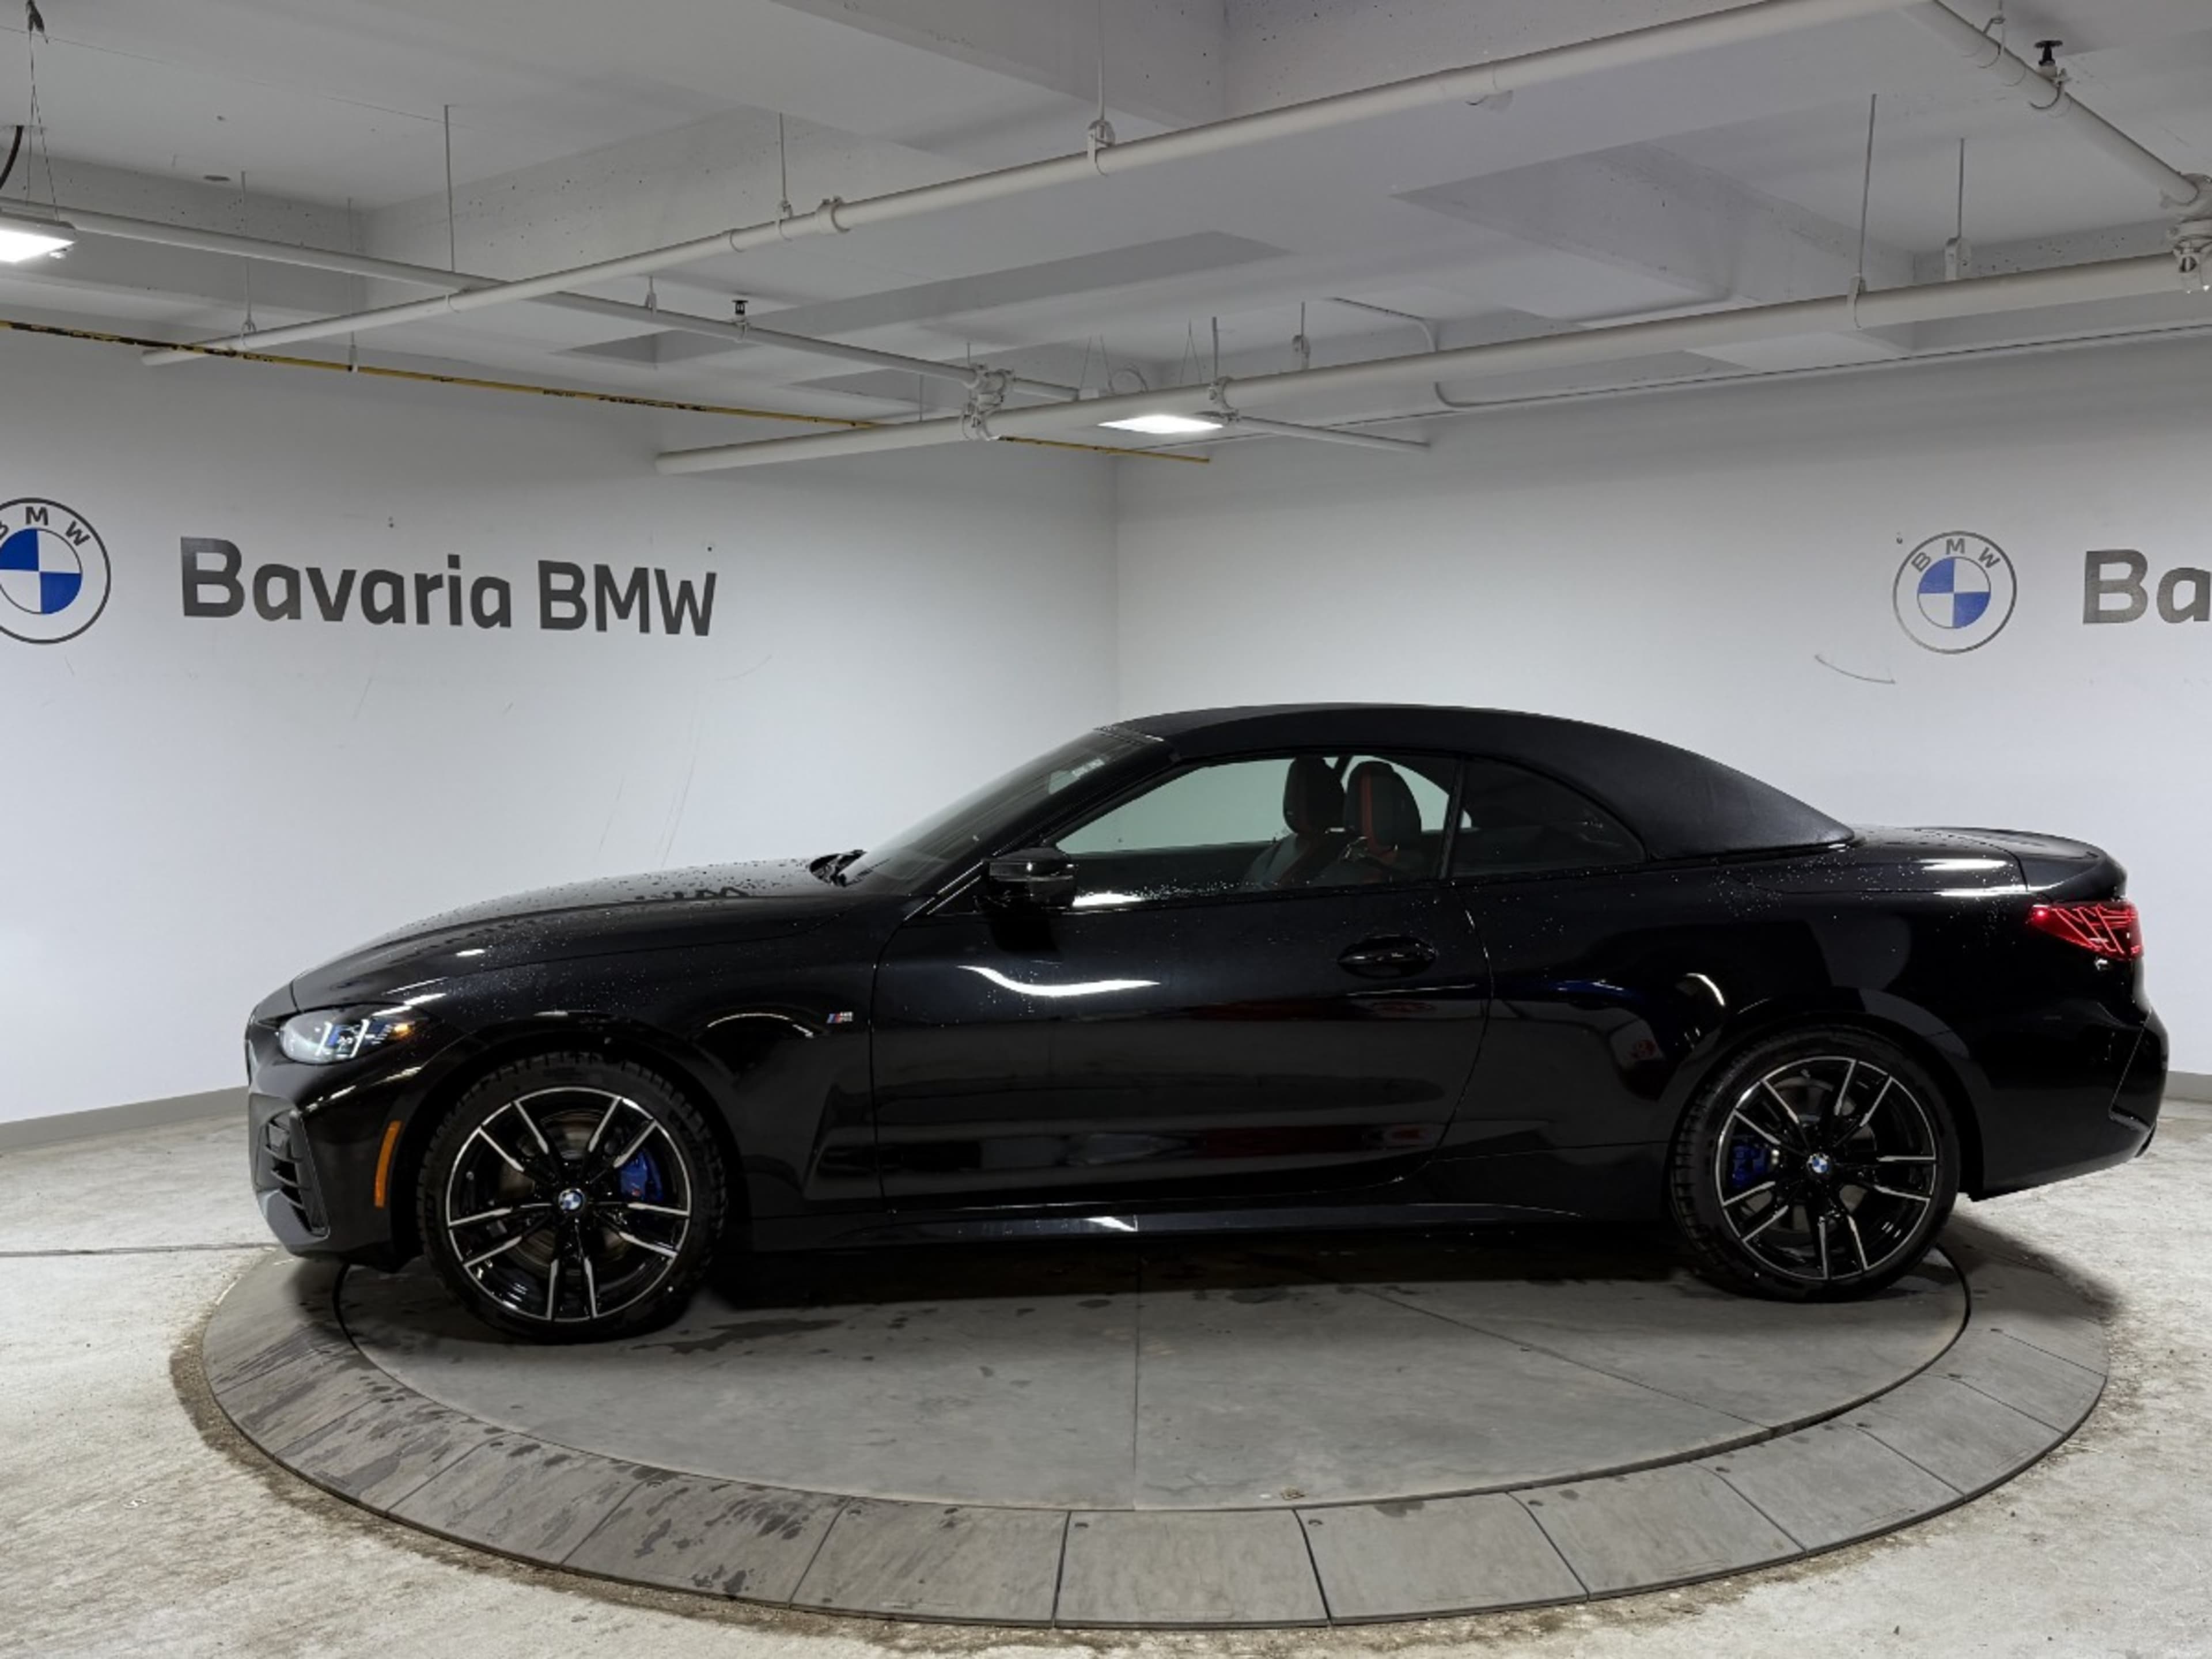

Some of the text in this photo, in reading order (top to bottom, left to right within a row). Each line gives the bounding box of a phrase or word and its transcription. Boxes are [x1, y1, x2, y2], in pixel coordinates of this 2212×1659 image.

[180, 537, 717, 637] Bavaria BMW
[1911, 537, 2001, 572] BMW
